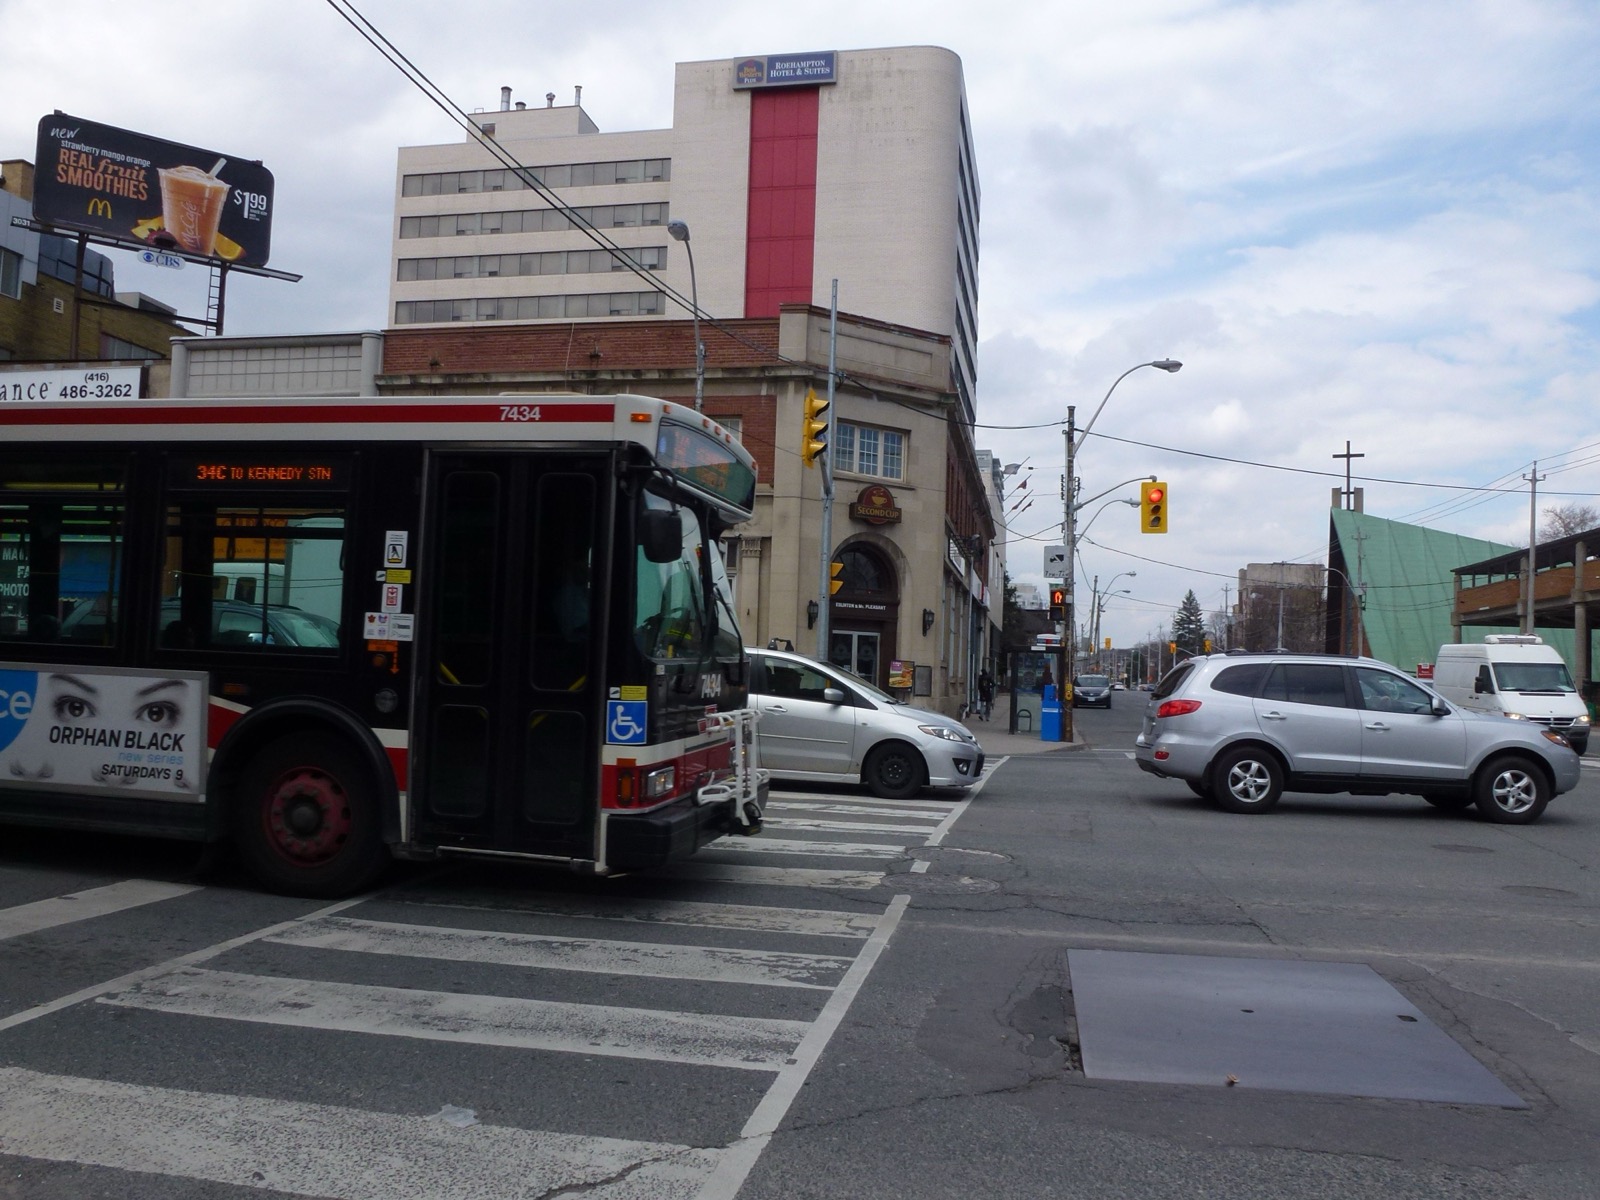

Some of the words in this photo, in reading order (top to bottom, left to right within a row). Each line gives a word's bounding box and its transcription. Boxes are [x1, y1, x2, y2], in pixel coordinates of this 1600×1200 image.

[770, 69, 795, 77] HOTEL
[796, 68, 803, 76] &
[804, 66, 830, 75] SUITES
[775, 60, 826, 70] ROEHAMPTON
[50, 127, 80, 139] new
[61, 140, 100, 156] strawberry
[101, 149, 125, 162] mango
[126, 155, 151, 168] orange
[60, 148, 95, 171] REAL
[98, 158, 147, 182] fruit
[57, 164, 149, 201] SMOOTHIES
[12, 217, 31, 227] 3031
[156, 255, 180, 267] CBS
[84, 372, 109, 384] (416)
[59, 383, 132, 399] 486-3262
[500, 406, 541, 421] 7434
[197, 465, 226, 480] 34C
[230, 466, 243, 480] TO
[248, 466, 303, 480] KENNEDY
[308, 466, 331, 480] STN
[857, 506, 885, 517] SECOND
[885, 510, 899, 518] CUP
[701, 673, 722, 698] 7434
[49, 725, 121, 748] ORPHAN
[124, 730, 185, 752] BLACK
[118, 752, 143, 762] new
[147, 752, 184, 765] series
[101, 763, 171, 780] SATURDAYS
[175, 769, 183, 780] 9
